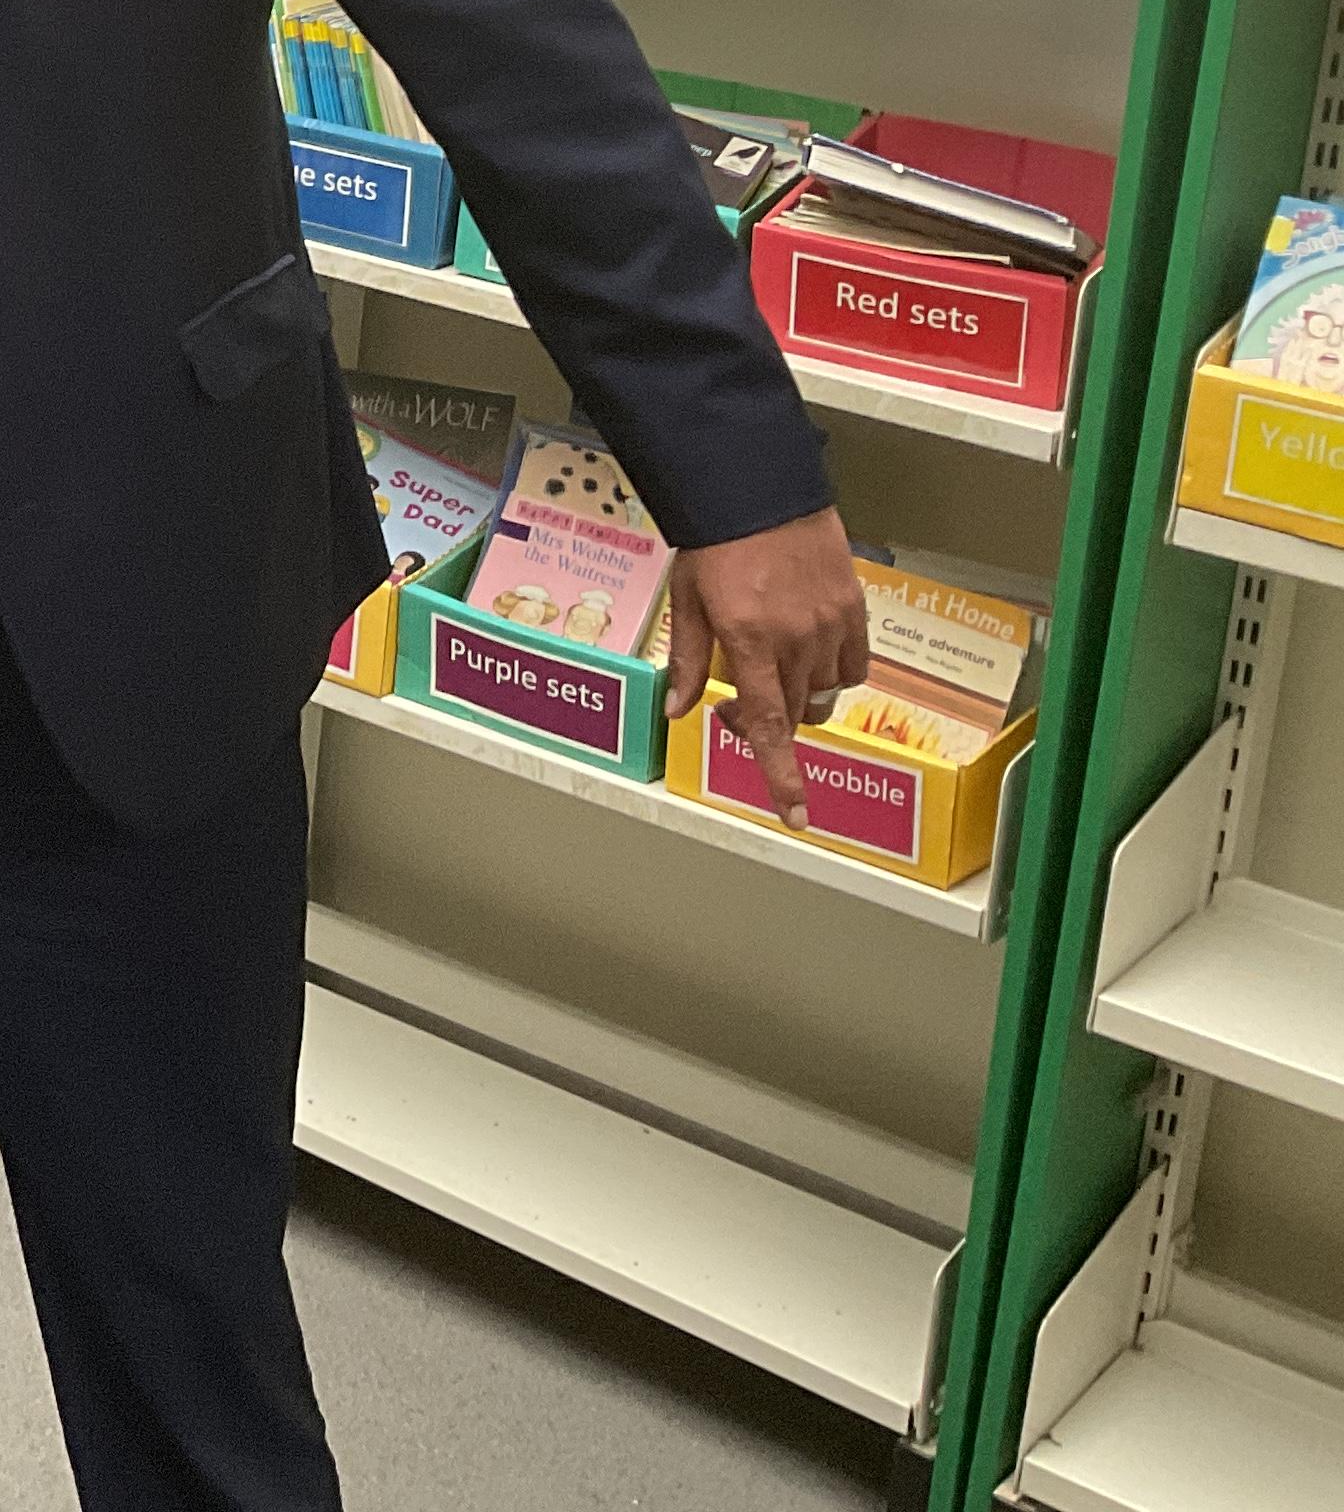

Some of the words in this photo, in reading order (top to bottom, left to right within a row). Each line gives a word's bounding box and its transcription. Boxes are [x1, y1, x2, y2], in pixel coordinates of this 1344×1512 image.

[322, 172, 378, 201] sets
[835, 282, 899, 321] Red
[909, 303, 980, 336] sets
[415, 393, 501, 432] WOLF
[389, 470, 475, 516] Super
[403, 503, 465, 537] Dad
[524, 546, 551, 565] the
[558, 554, 626, 590] Waitress
[529, 526, 564, 549] Mrs
[572, 539, 634, 573] Wobble
[914, 588, 940, 613] at
[944, 592, 1015, 641] Home
[881, 618, 924, 642] Castle
[928, 637, 996, 669] adventure
[449, 637, 538, 691] Purple
[545, 676, 605, 713] sets
[804, 761, 905, 807] wobble
